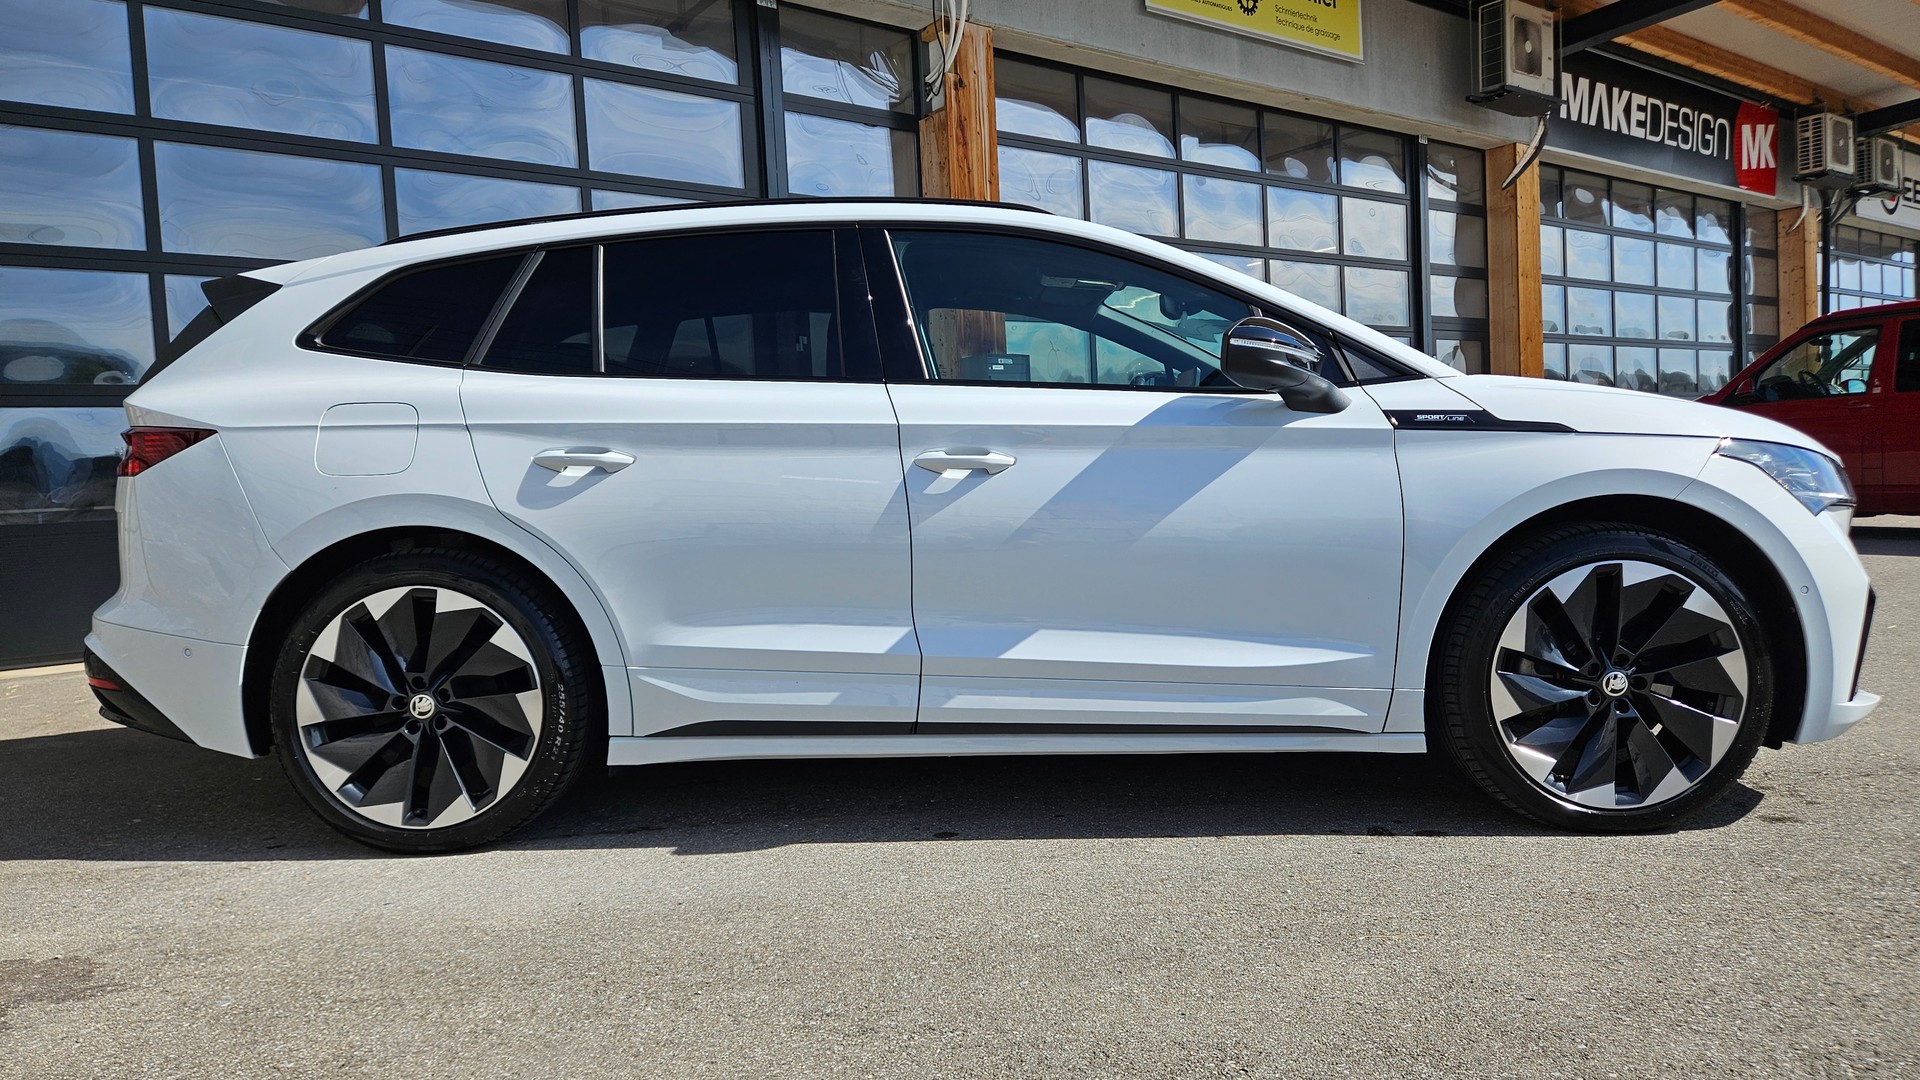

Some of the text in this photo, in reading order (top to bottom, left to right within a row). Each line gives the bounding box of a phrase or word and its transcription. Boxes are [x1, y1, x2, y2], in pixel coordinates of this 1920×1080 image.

[1275, 4, 1318, 22] Schmiertechnik
[1275, 16, 1341, 41] Technique de graissage
[1560, 71, 1730, 160] MAKEDESIGN
[1741, 124, 1776, 170] MK
[557, 682, 566, 733] 255/40
